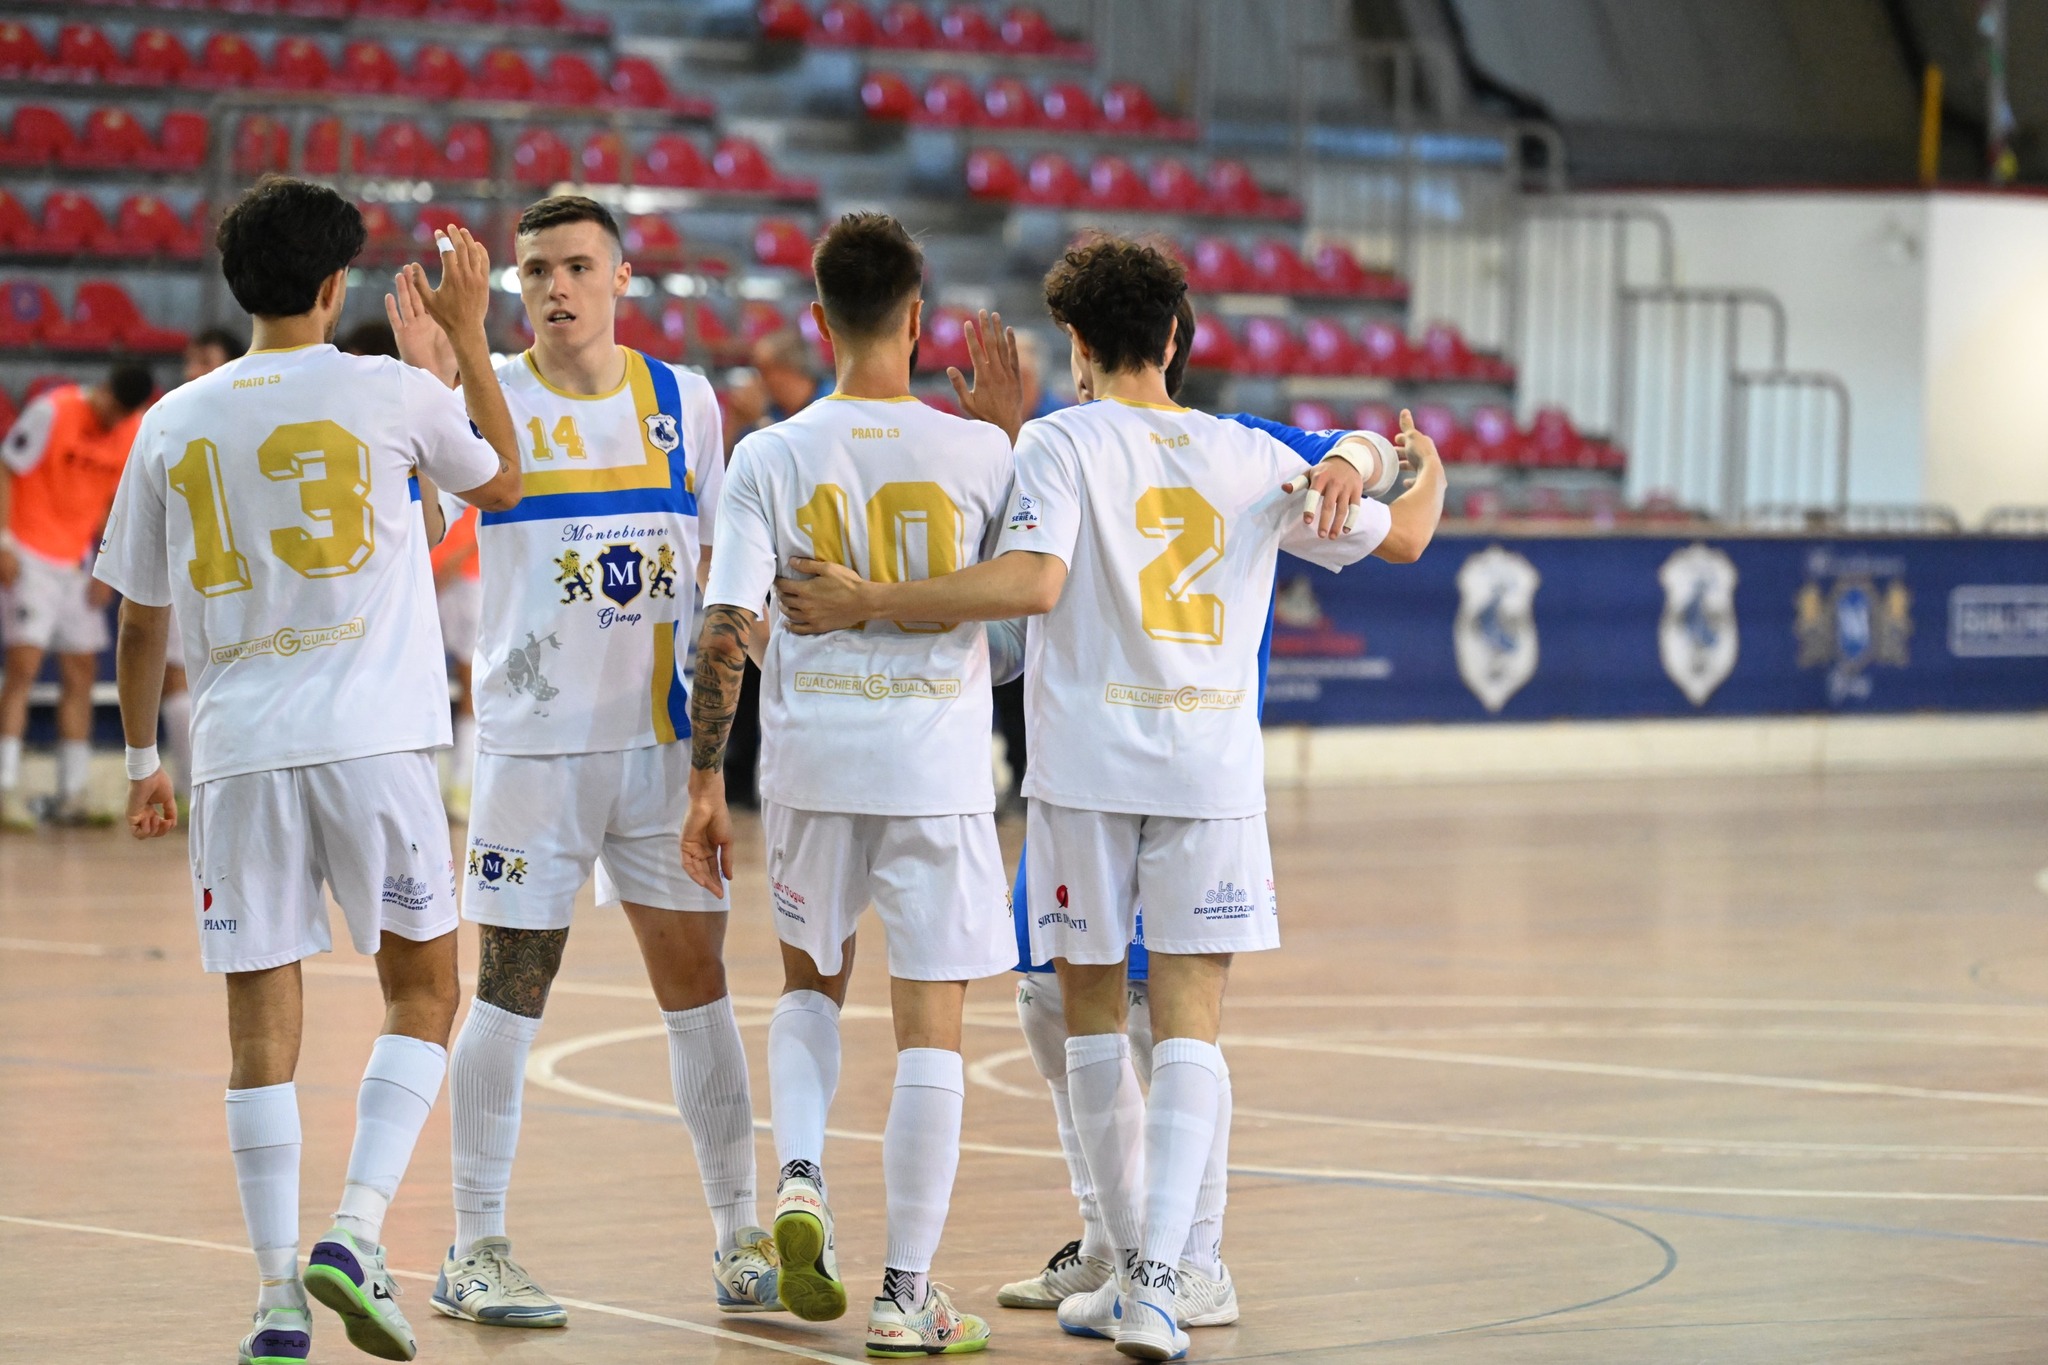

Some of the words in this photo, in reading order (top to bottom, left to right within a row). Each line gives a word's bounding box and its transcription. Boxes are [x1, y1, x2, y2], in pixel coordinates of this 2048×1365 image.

[233, 377, 265, 389] PRATO
[268, 374, 281, 385] C5
[526, 416, 587, 462] 14
[851, 428, 883, 439] PRATO
[887, 428, 900, 439] C5
[1177, 434, 1190, 447] C5
[168, 419, 375, 598] 13
[796, 482, 964, 634] 10
[1136, 486, 1225, 646] 2
[606, 560, 637, 587] M
[597, 606, 642, 629] Group
[799, 676, 862, 691] GUALCHIERI
[892, 682, 956, 695] GUALCHIERI
[1110, 687, 1174, 704] GUALCHIERI
[485, 859, 500, 874] M
[1218, 880, 1234, 892] La
[1038, 912, 1063, 929] SIRTE
